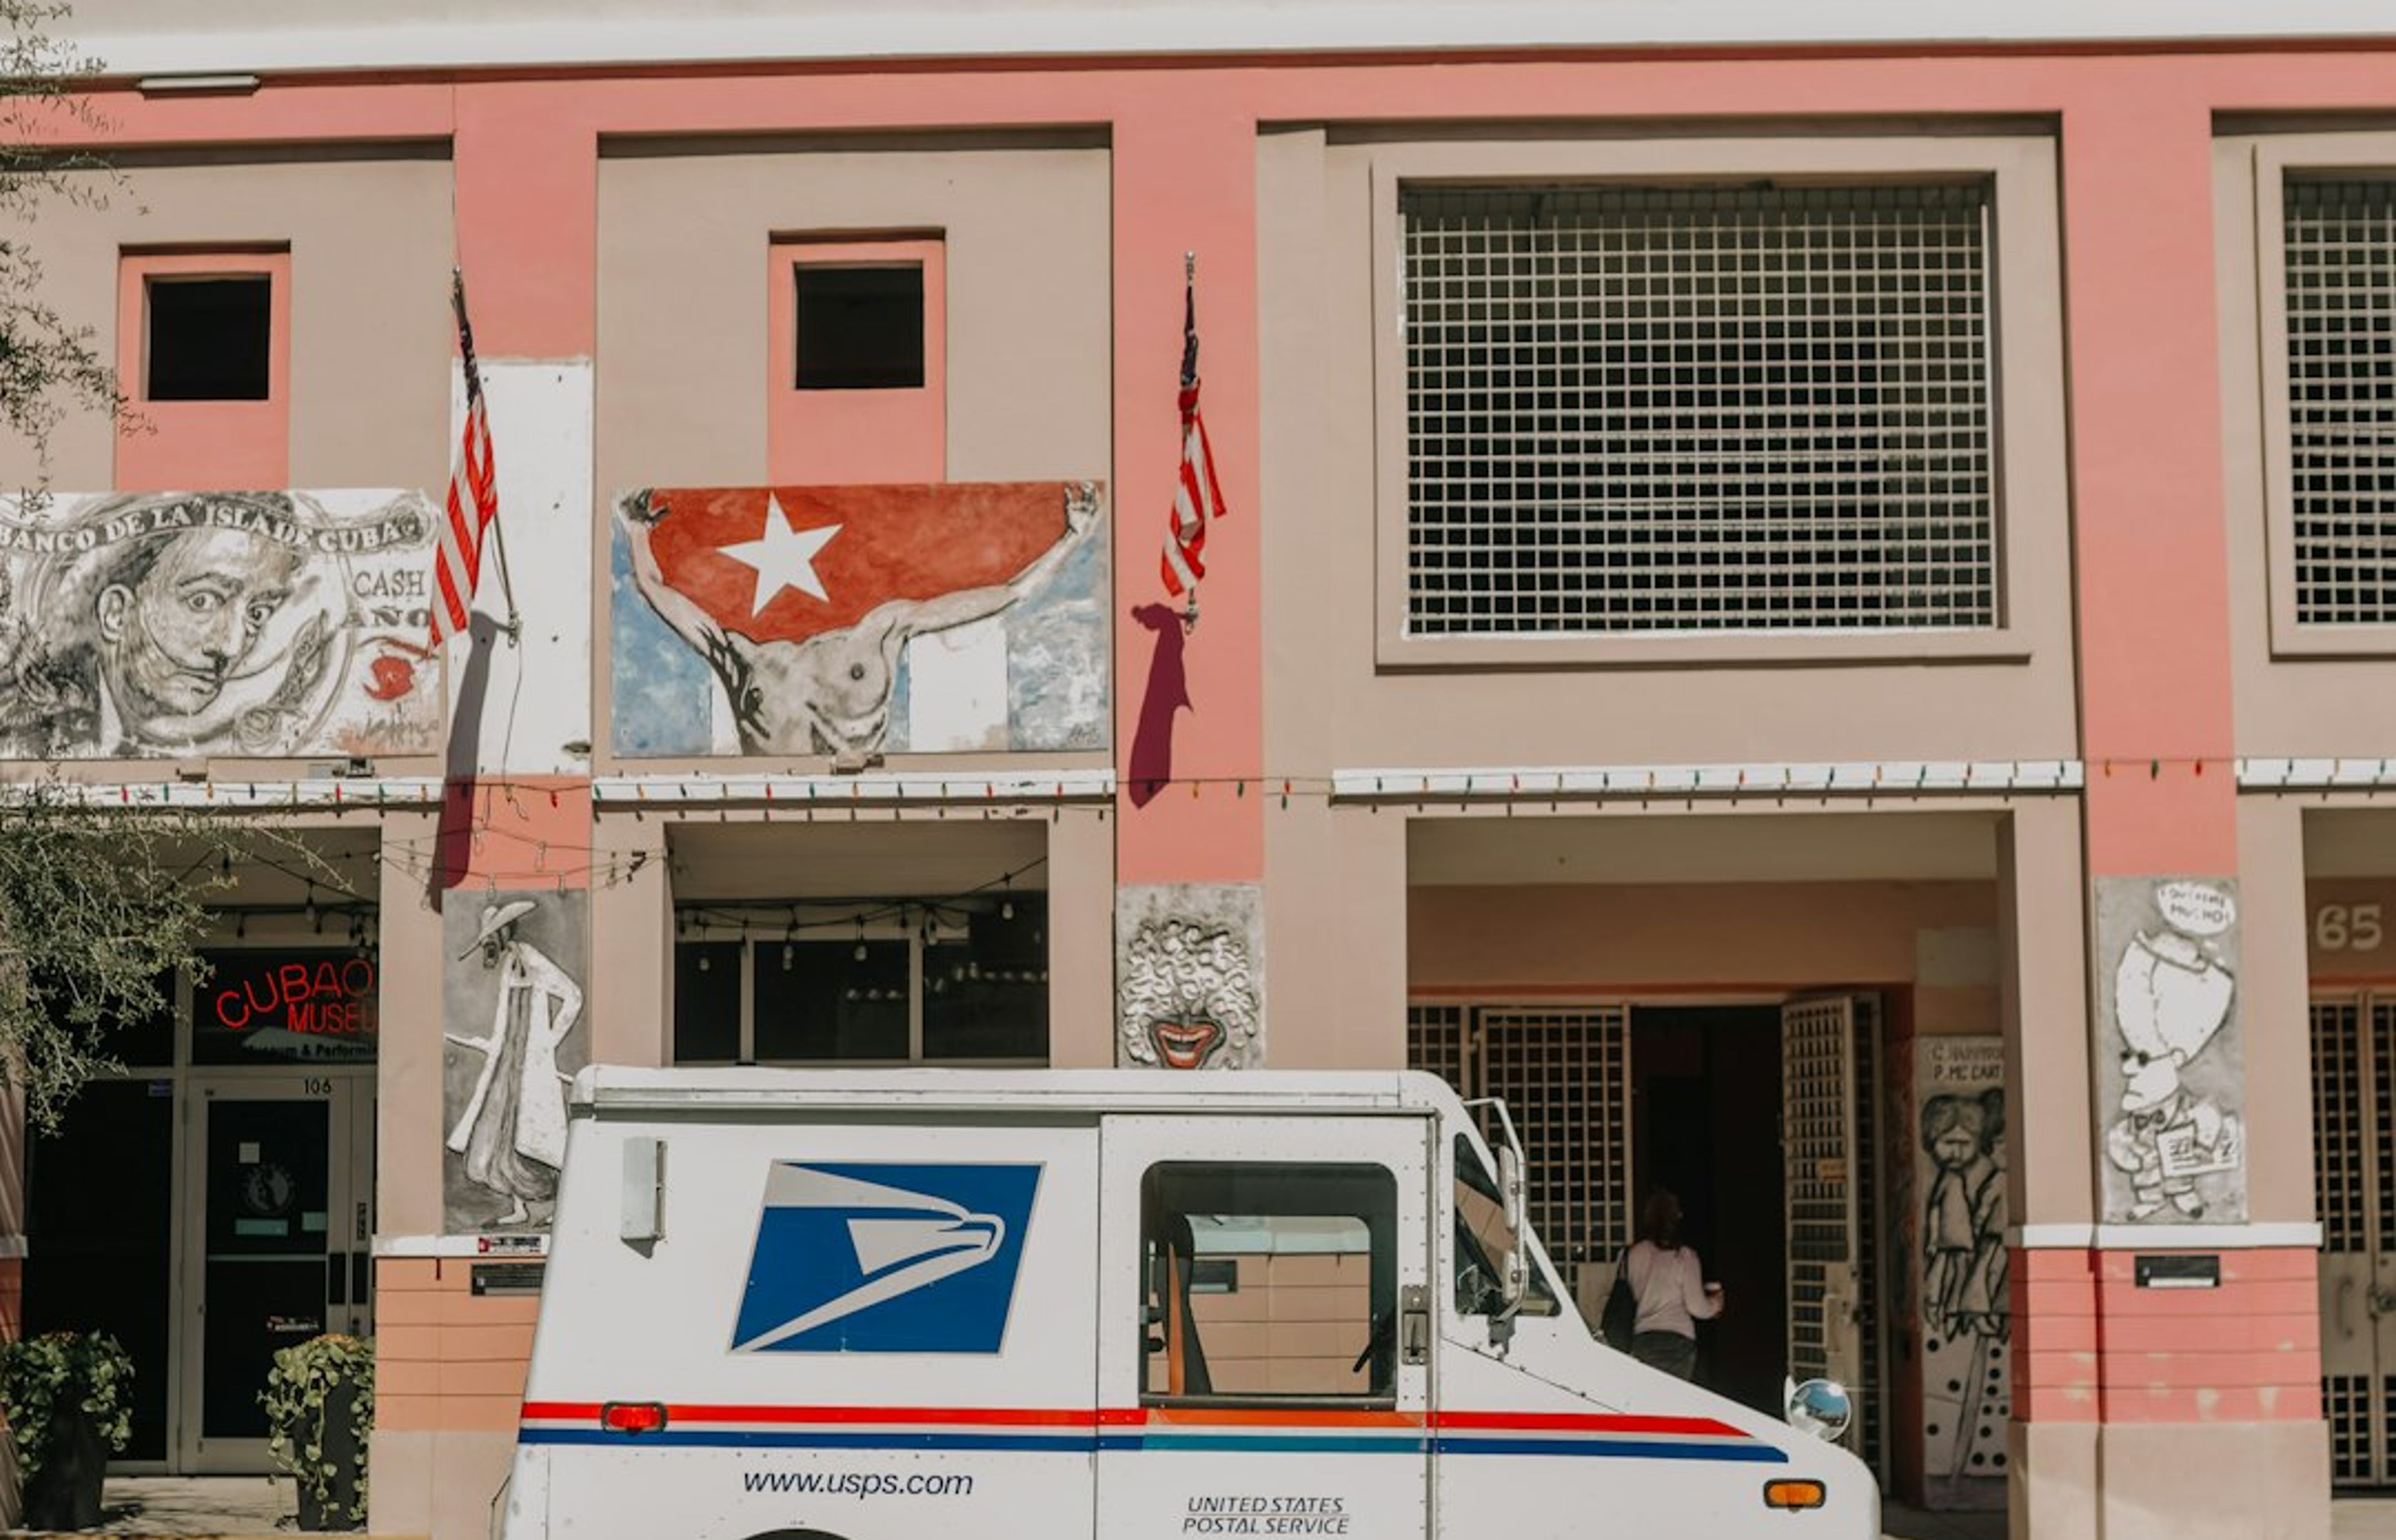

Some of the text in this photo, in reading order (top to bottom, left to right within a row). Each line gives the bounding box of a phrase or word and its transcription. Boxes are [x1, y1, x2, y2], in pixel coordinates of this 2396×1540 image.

[0, 504, 401, 552] BANCO DE LA ISLA DE CUBA
[353, 568, 425, 597] CASH
[2317, 904, 2382, 949] 65
[216, 959, 373, 1029] CUBAO
[304, 1078, 331, 1093] 106
[744, 1473, 973, 1499] www.usps.com
[1188, 1497, 1345, 1513] UNITED STATES
[1184, 1518, 1350, 1534] POSTAL SERVICE
